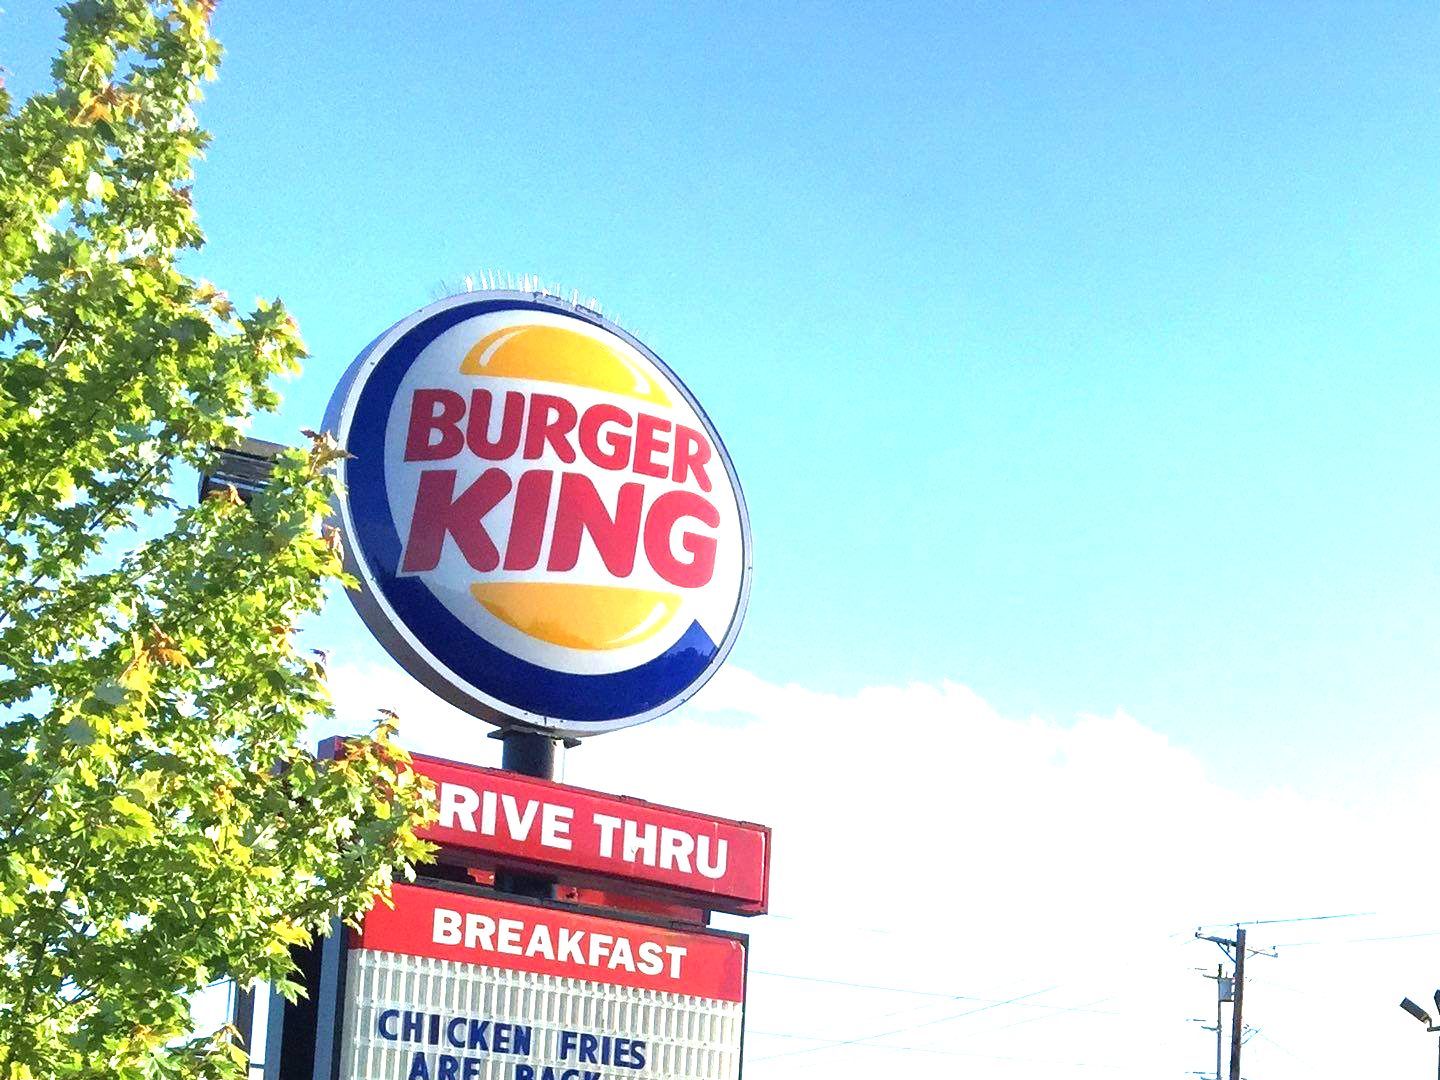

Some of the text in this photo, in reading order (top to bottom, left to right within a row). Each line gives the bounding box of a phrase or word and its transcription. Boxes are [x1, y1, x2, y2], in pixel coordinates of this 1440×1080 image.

[404, 388, 712, 492] BURGER
[403, 468, 721, 588] KING
[436, 782, 728, 879] RIVE THRU
[432, 907, 688, 979] BREAKFAST
[378, 1008, 646, 1071] CHICKEN FRIES
